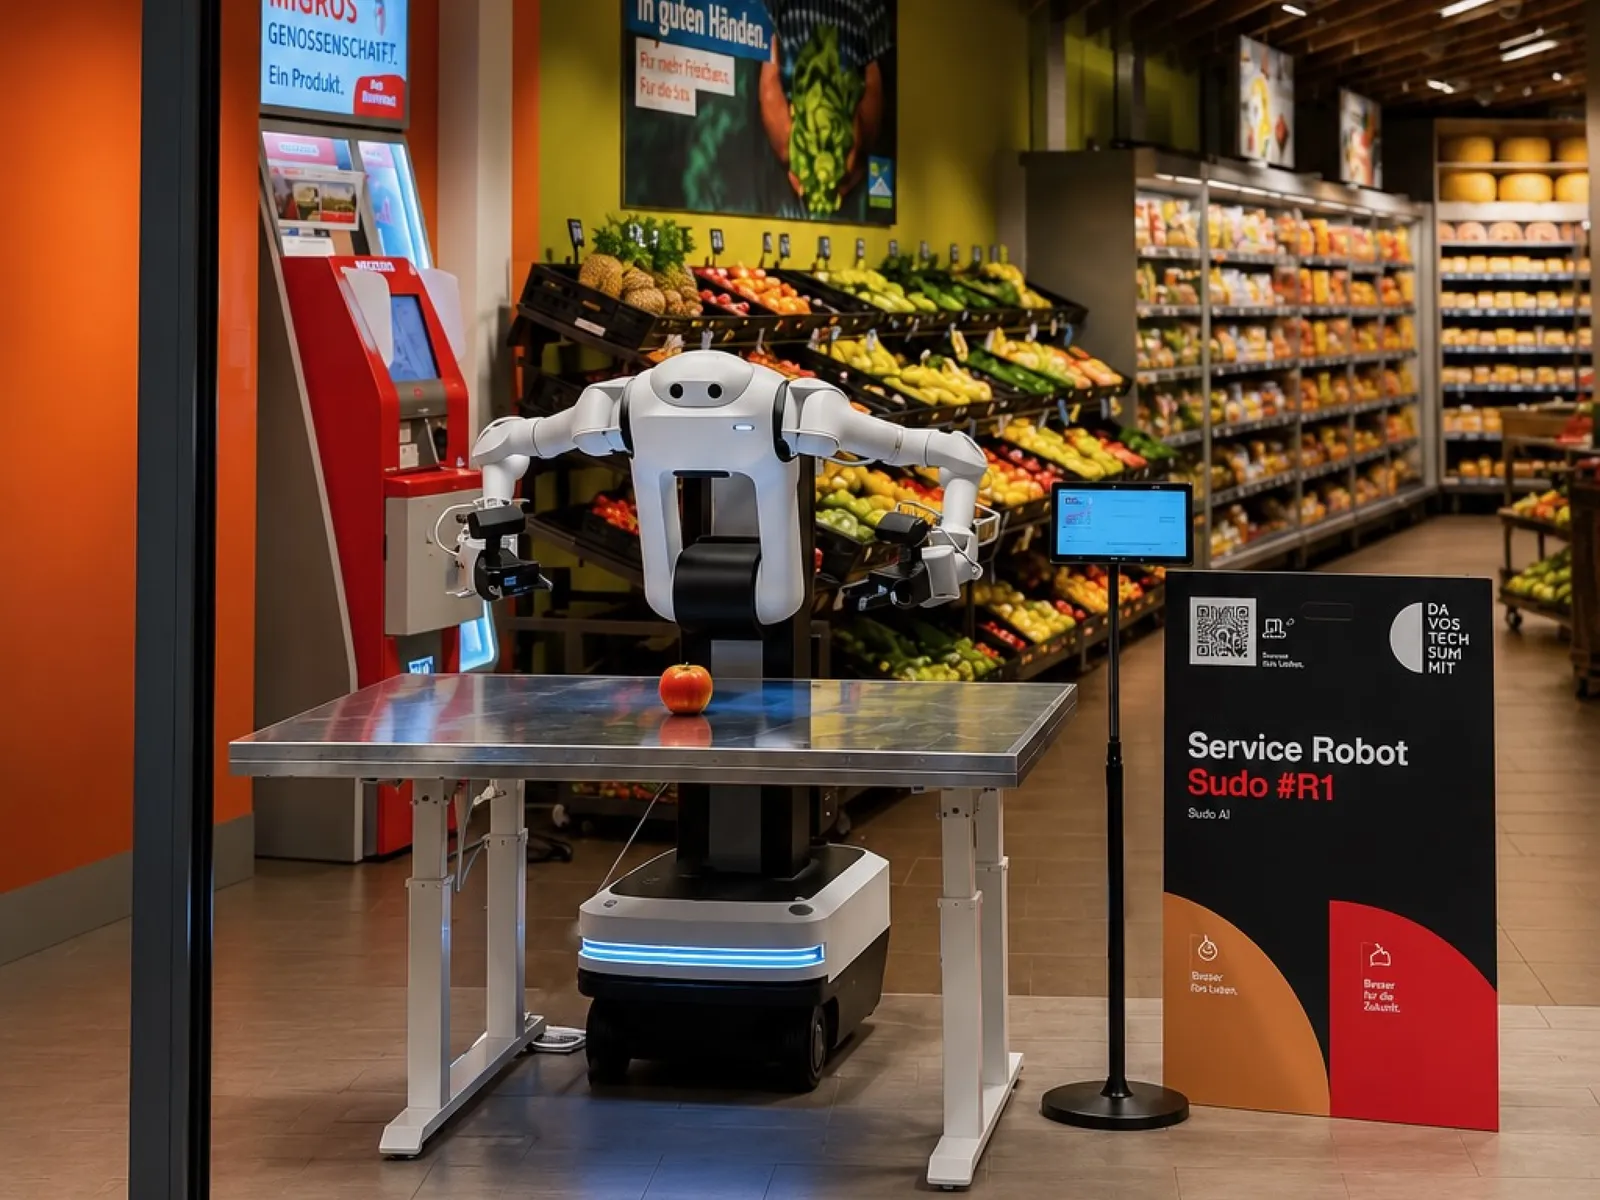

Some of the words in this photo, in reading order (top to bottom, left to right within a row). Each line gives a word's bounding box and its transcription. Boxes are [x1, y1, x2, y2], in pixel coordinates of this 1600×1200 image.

[659, 0, 705, 36] guten
[709, 4, 768, 49] Händen.
[269, 65, 288, 87] Ein
[292, 68, 345, 95] Produkt.
[1427, 602, 1449, 616] DA
[1427, 617, 1461, 630] VOS
[1427, 632, 1470, 646] TECH
[1427, 646, 1462, 660] SUM
[1428, 661, 1456, 675] MIT
[1188, 730, 1303, 762] Service
[1312, 736, 1409, 766] Robot
[1188, 768, 1268, 798] Sudo
[1277, 771, 1334, 801] #R1
[1188, 807, 1216, 819] Sudo
